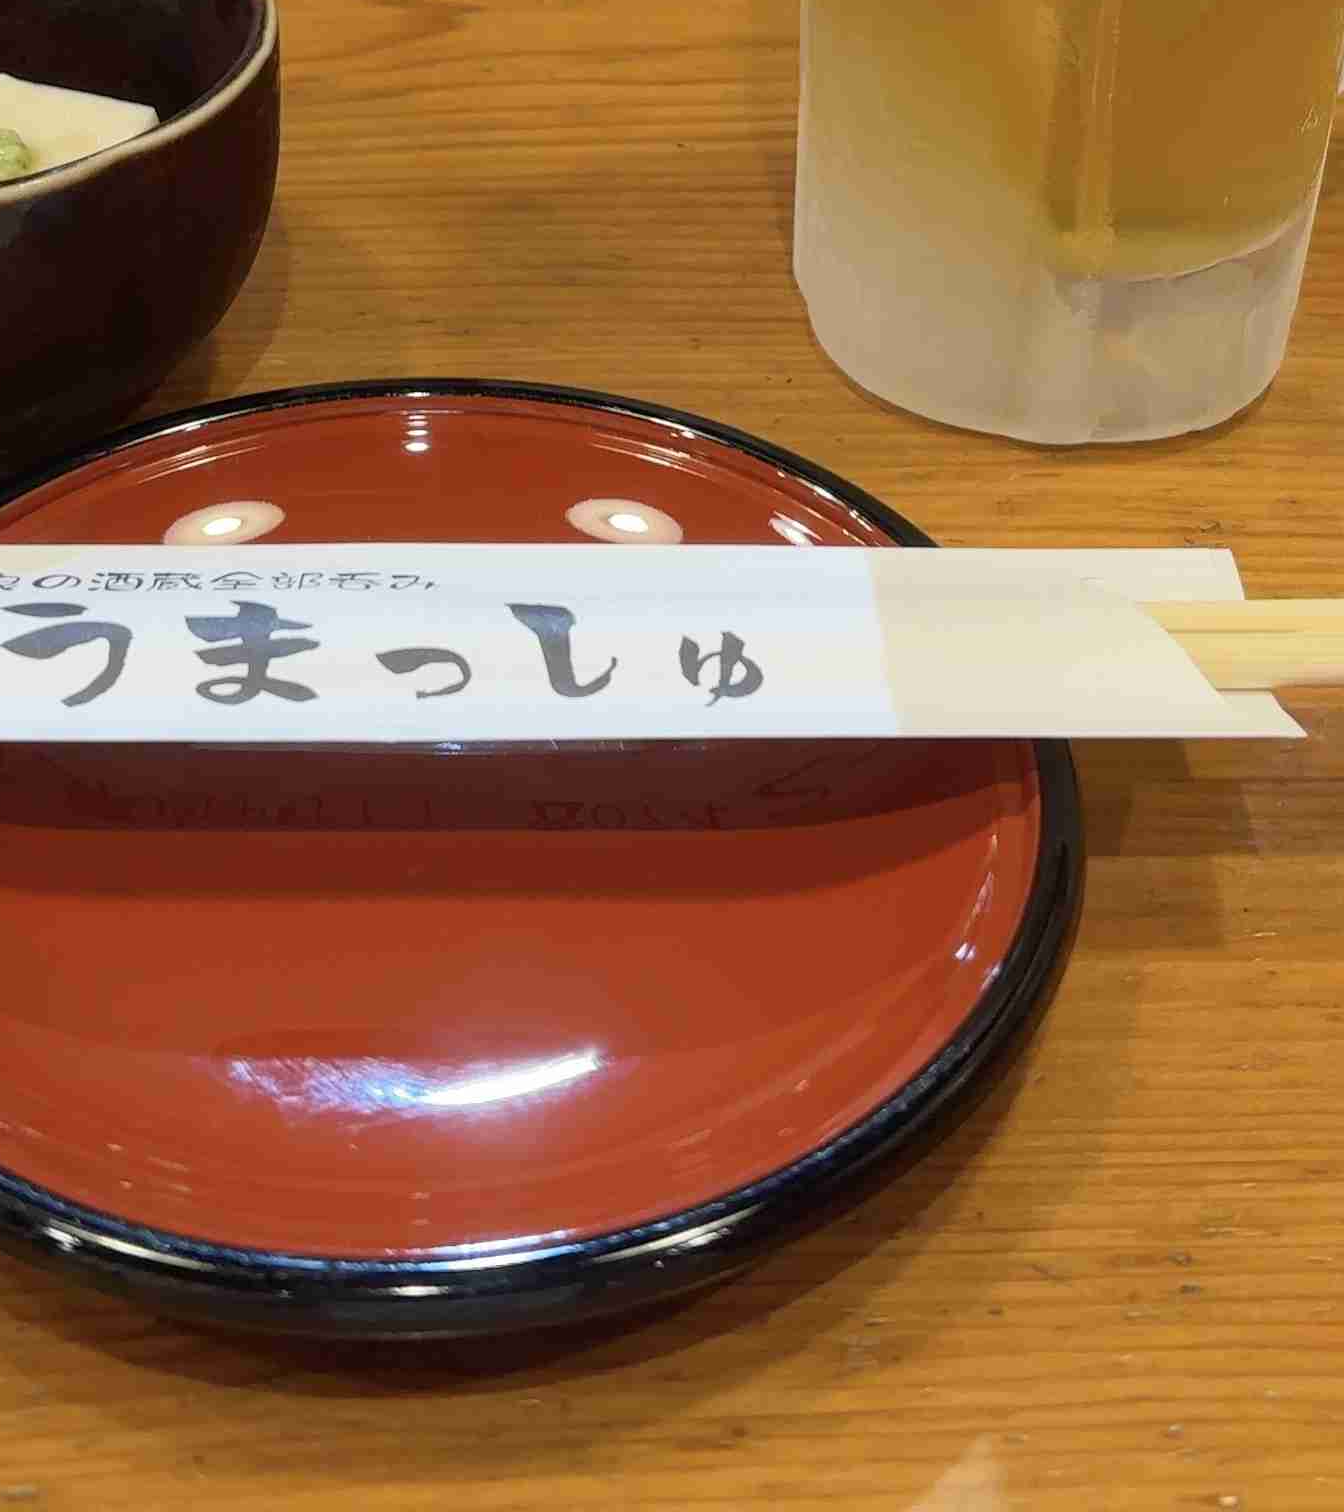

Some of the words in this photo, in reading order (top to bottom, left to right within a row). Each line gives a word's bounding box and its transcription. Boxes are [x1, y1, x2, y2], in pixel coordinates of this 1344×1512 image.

[0, 599, 763, 708] うまっしゅ
